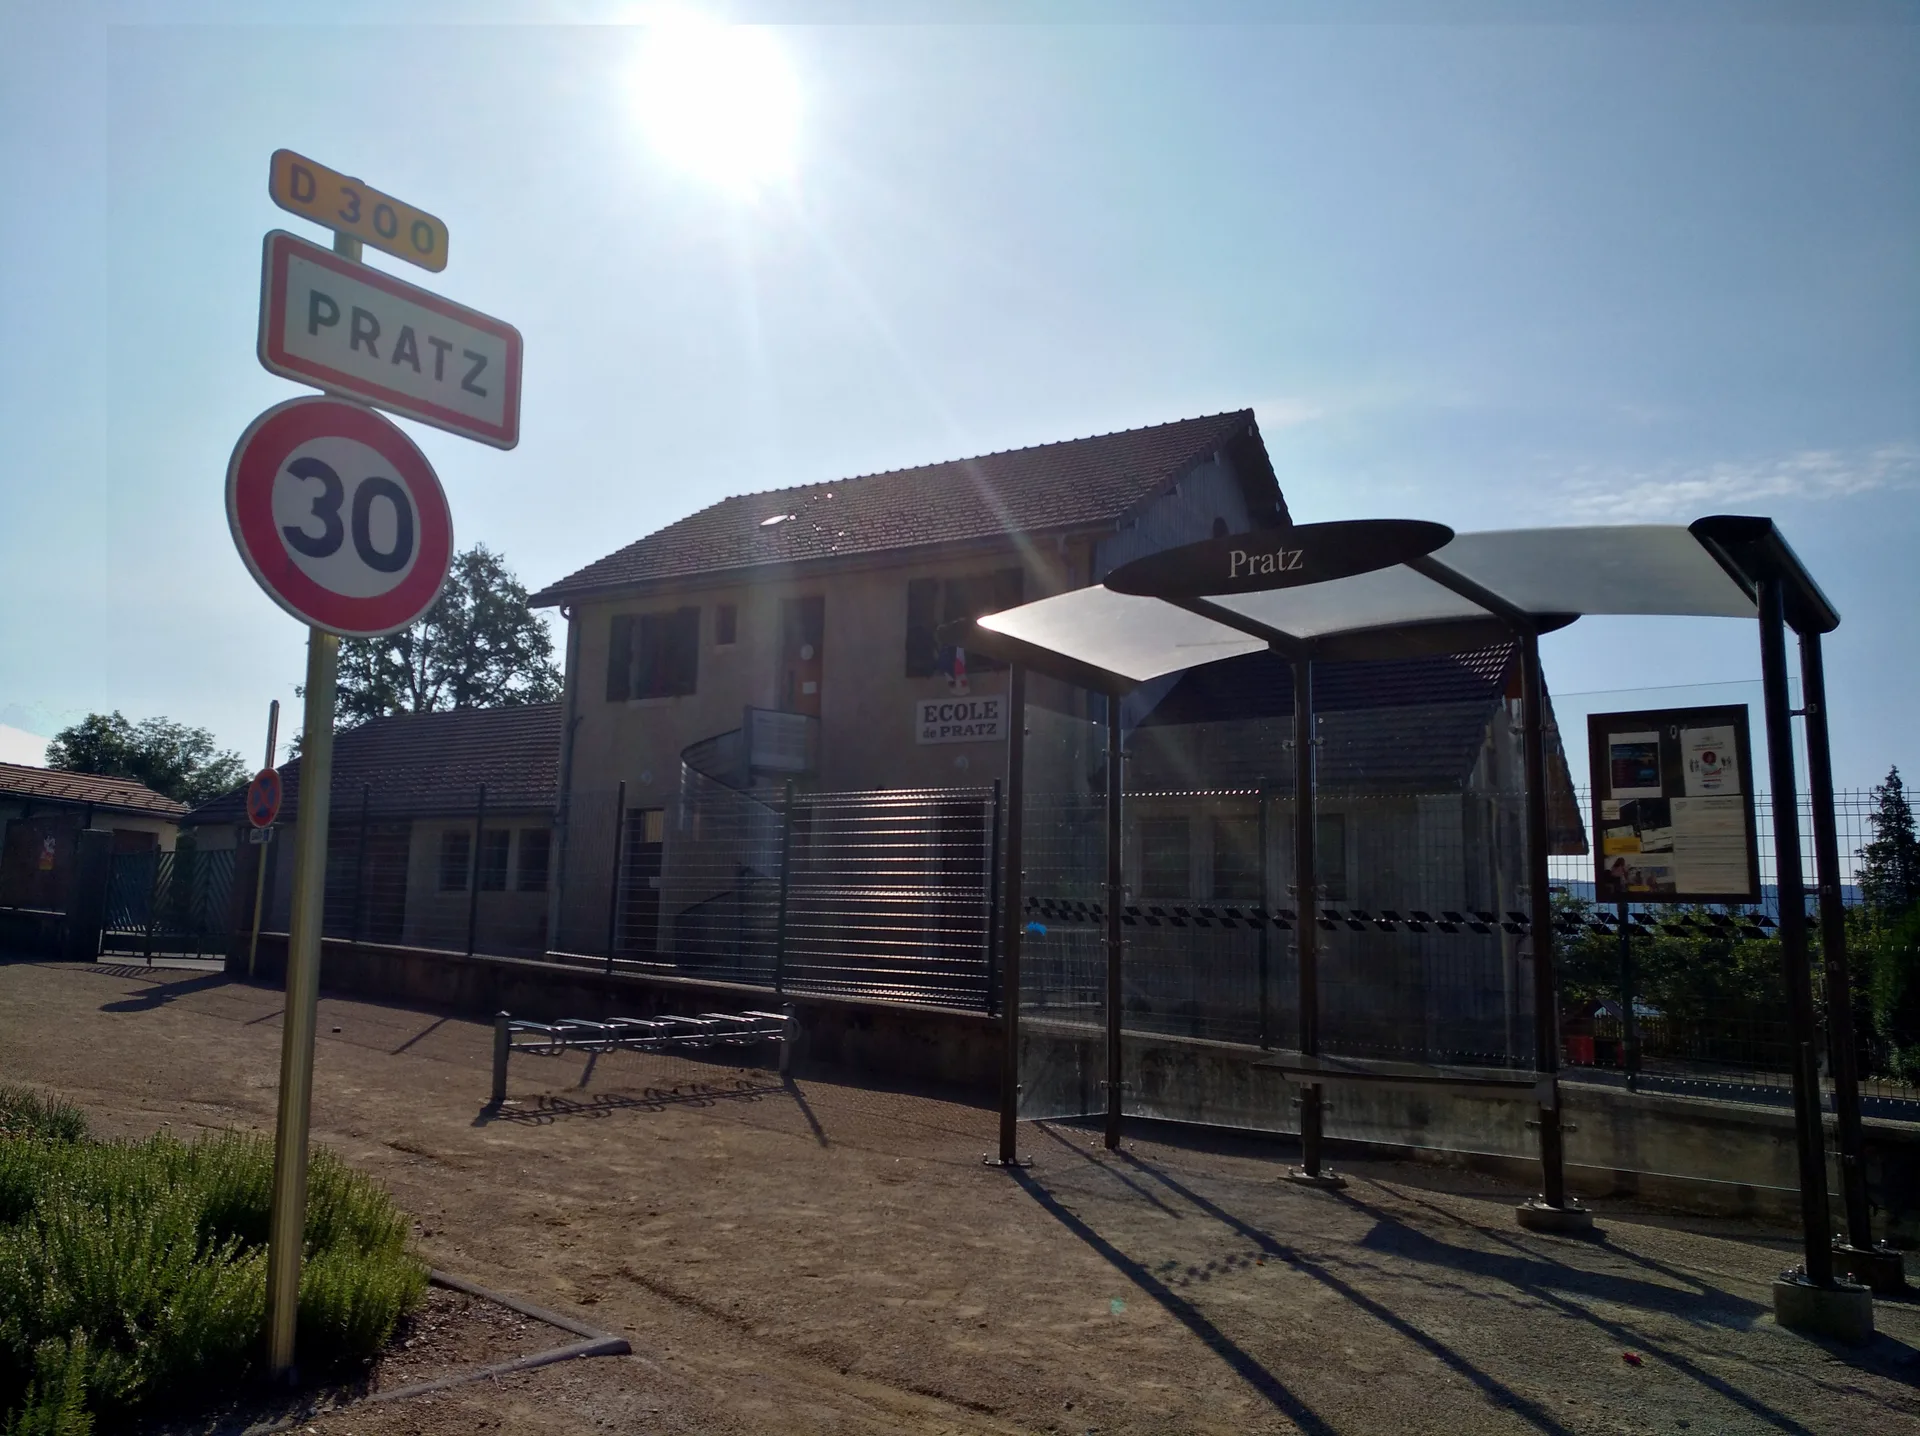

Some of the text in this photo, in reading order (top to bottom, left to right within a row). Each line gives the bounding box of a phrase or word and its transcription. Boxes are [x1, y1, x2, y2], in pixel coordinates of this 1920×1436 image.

[289, 163, 435, 256] D 300
[307, 289, 489, 398] PRATZ
[282, 456, 414, 573] 30
[1228, 546, 1304, 579] Pratz
[923, 723, 997, 738] de PRATZ
[924, 701, 998, 723] ECOLE
